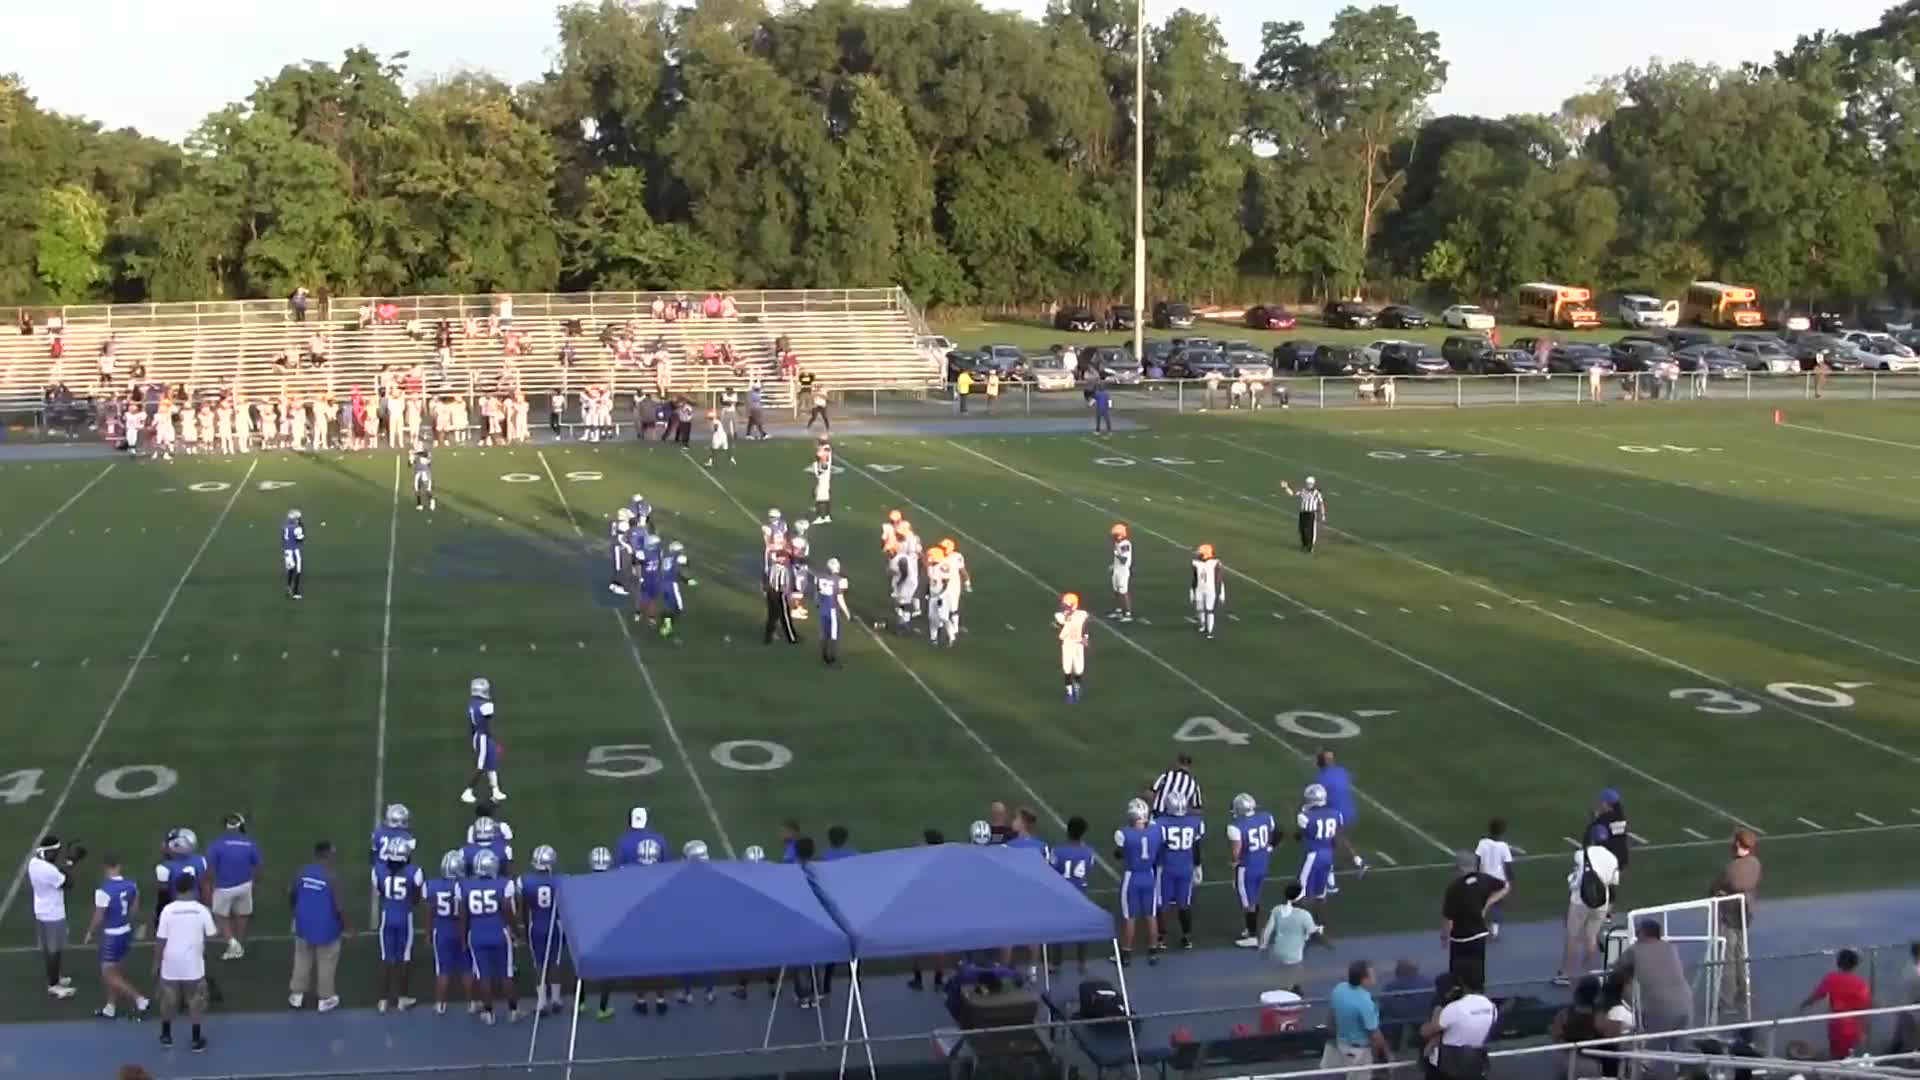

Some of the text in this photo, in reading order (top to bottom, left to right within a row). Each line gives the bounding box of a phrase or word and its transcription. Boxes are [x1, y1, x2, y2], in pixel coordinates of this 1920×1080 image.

[1247, 825, 1270, 852] 50
[1315, 818, 1337, 839] 18
[1140, 837, 1149, 860] 1
[1063, 860, 1086, 880] 14
[383, 877, 407, 901] 15
[537, 885, 552, 909] 8
[468, 889, 498, 915] 65
